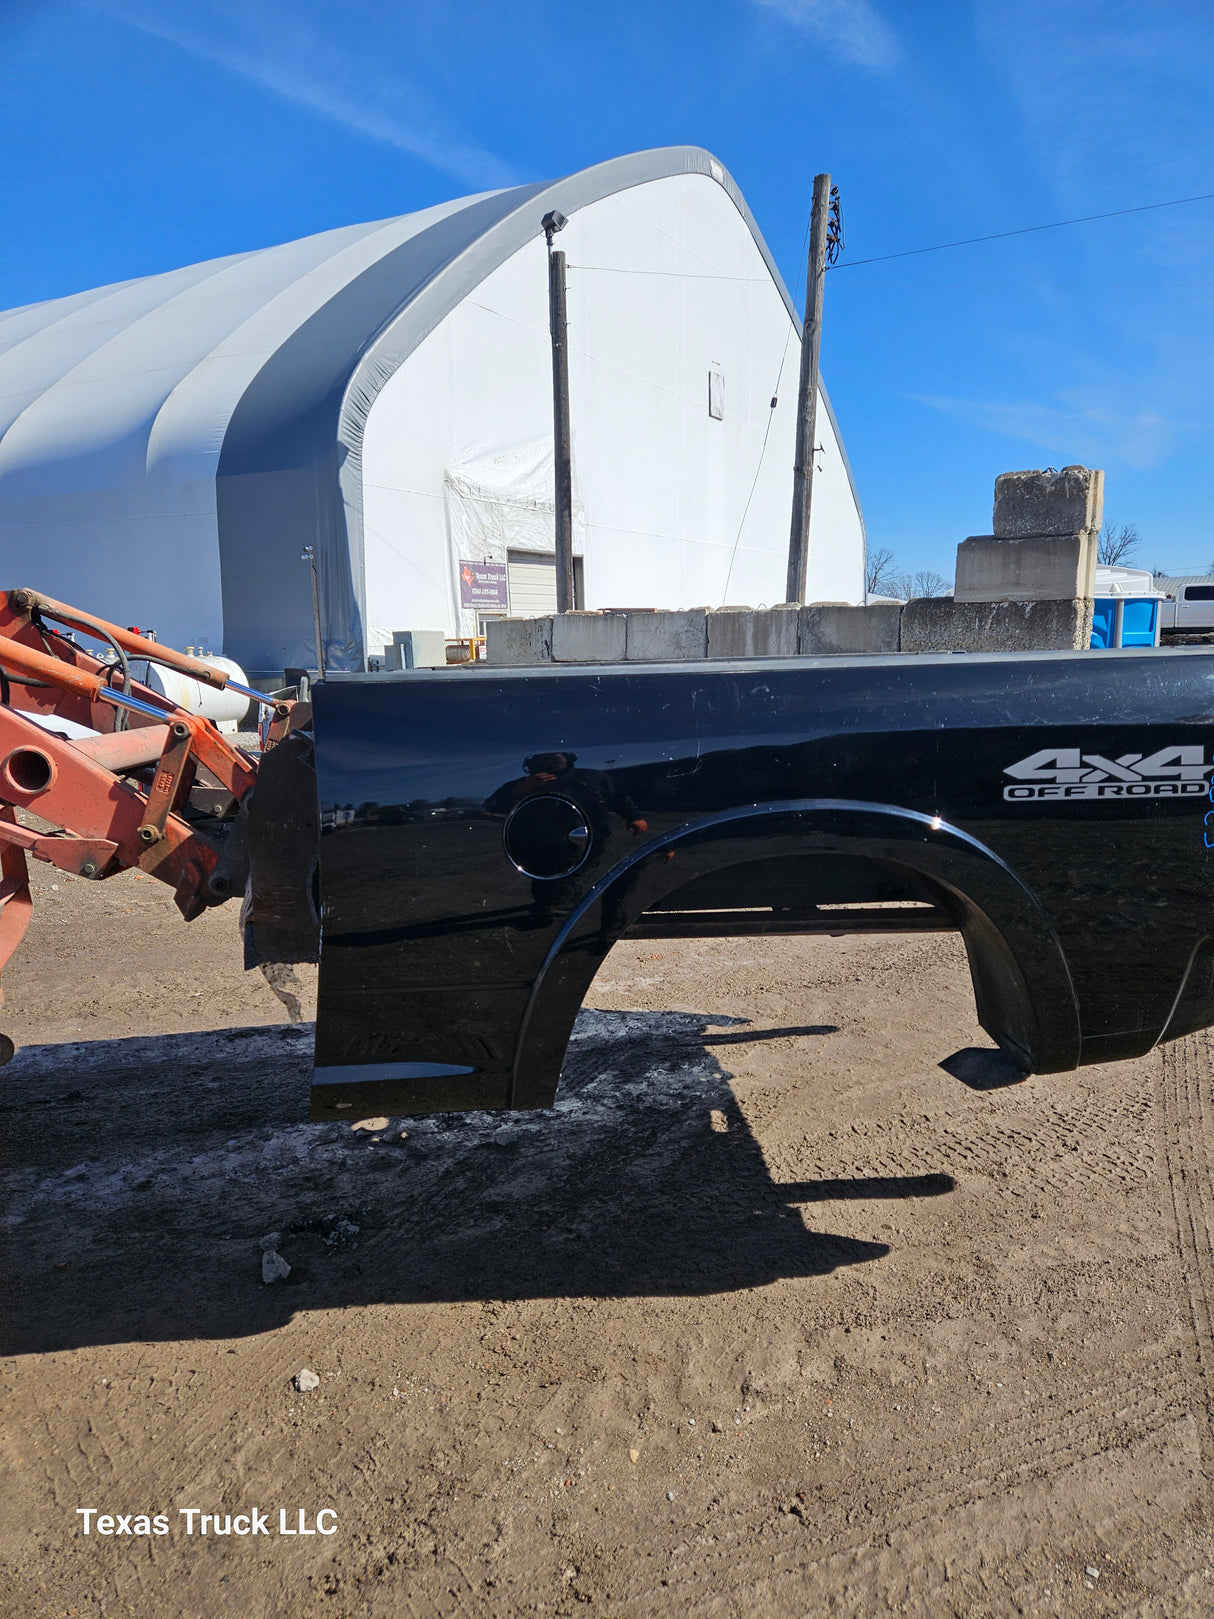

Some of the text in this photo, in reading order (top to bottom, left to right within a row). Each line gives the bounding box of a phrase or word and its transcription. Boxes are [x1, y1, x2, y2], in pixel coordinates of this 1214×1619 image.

[487, 573, 499, 581] Truck
[1007, 783, 1206, 798] OFF ROAD
